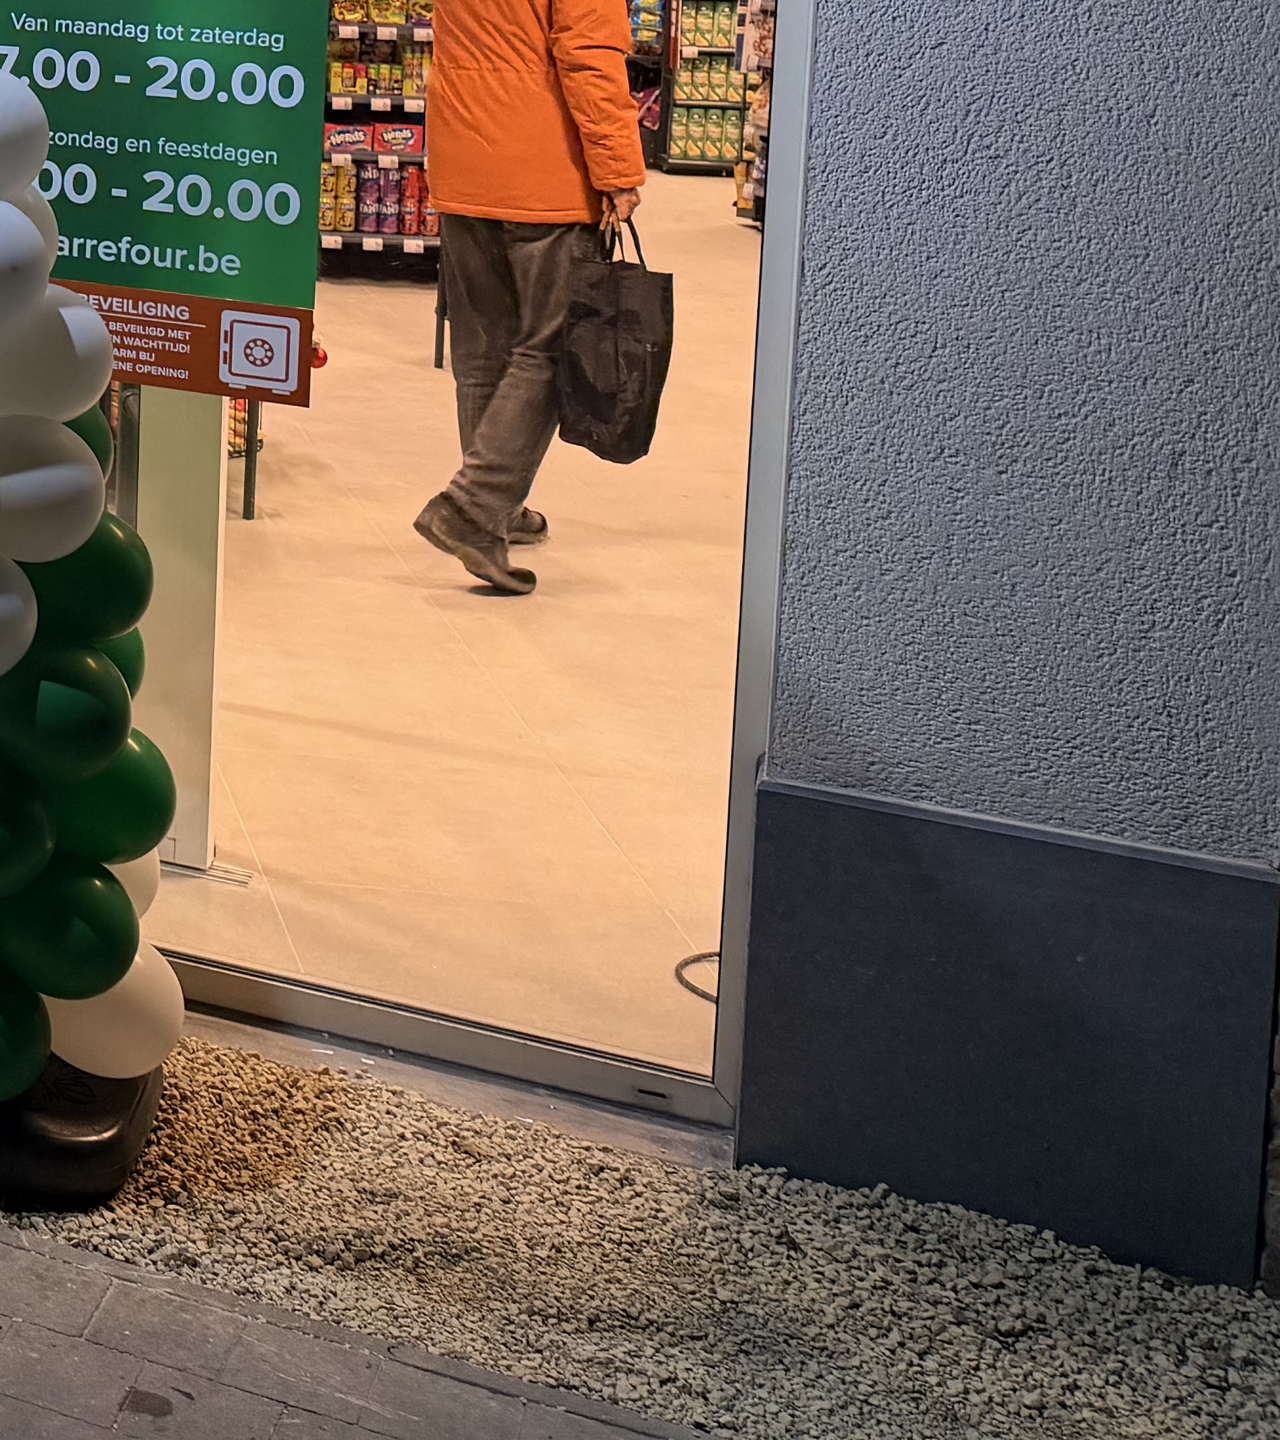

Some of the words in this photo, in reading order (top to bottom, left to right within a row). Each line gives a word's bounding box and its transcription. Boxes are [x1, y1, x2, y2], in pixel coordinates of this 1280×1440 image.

[10, 12, 48, 32] Van
[55, 16, 150, 43] maandag
[155, 22, 184, 41] tot
[190, 27, 285, 52] zaterdag
[114, 75, 131, 84] -
[145, 56, 305, 108] 20.00
[125, 138, 151, 154] en
[157, 137, 278, 167] feestdagen
[31, 160, 97, 204] 00
[111, 188, 127, 198] -
[142, 171, 301, 225] 20.00
[56, 234, 241, 277] arrefour.be
[109, 321, 165, 337] BEVEILIGD
[167, 329, 192, 340] MET
[112, 347, 137, 359] ARM
[135, 364, 189, 380] OPENING!
